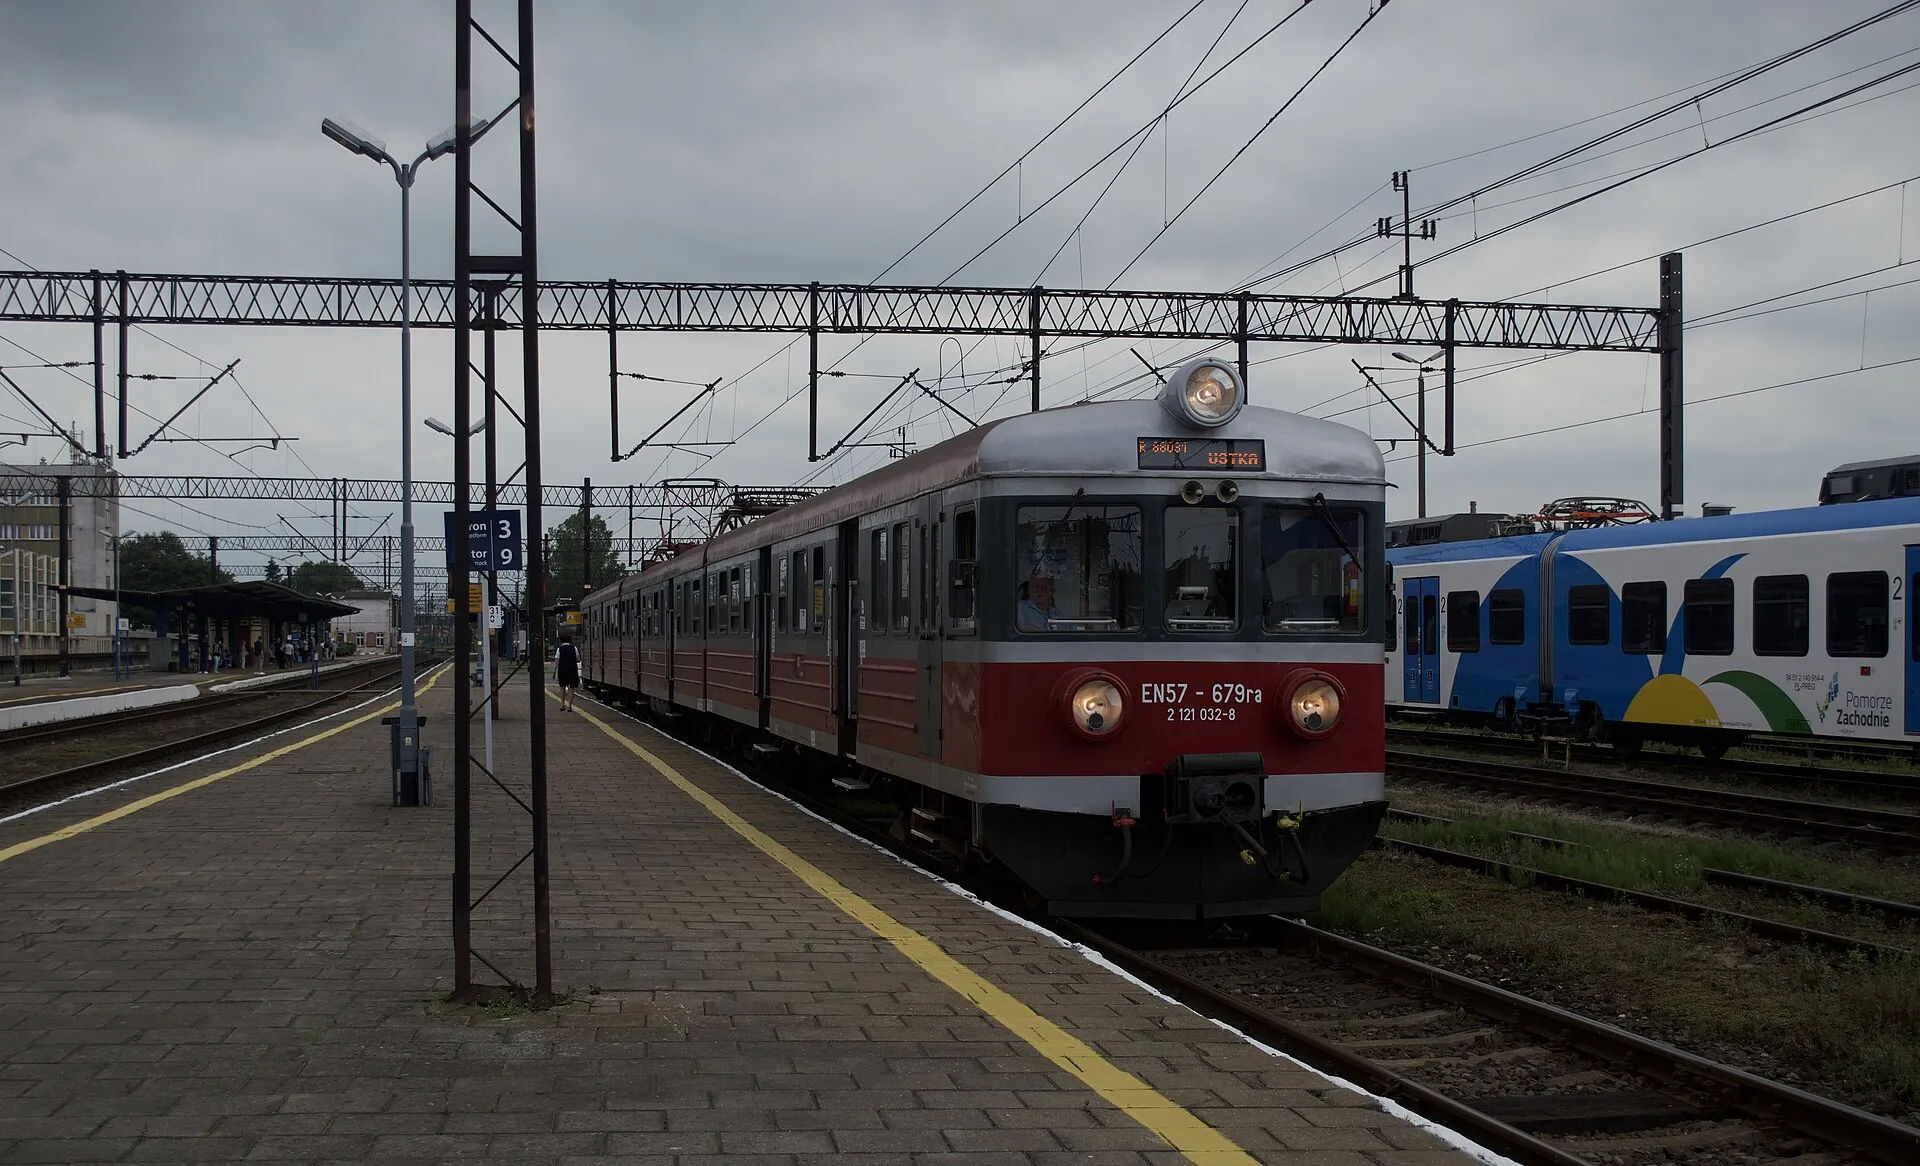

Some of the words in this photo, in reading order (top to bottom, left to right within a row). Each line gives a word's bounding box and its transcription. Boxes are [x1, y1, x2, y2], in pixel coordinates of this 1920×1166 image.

[1208, 452, 1259, 465] USTKA
[468, 523, 487, 531] ron
[499, 519, 511, 539] 3
[470, 550, 488, 559] tor
[501, 548, 513, 566] 9
[1893, 576, 1902, 600] 2
[1397, 598, 1403, 615] 2
[1440, 596, 1446, 613] 2
[1141, 683, 1188, 703] EN57
[1212, 683, 1262, 703] 679ra
[1846, 691, 1892, 709] Pomorze
[1167, 708, 1175, 721] 2
[1178, 708, 1195, 721] 121
[1200, 708, 1236, 721] 032-8
[1837, 709, 1890, 727] Zachodnie
